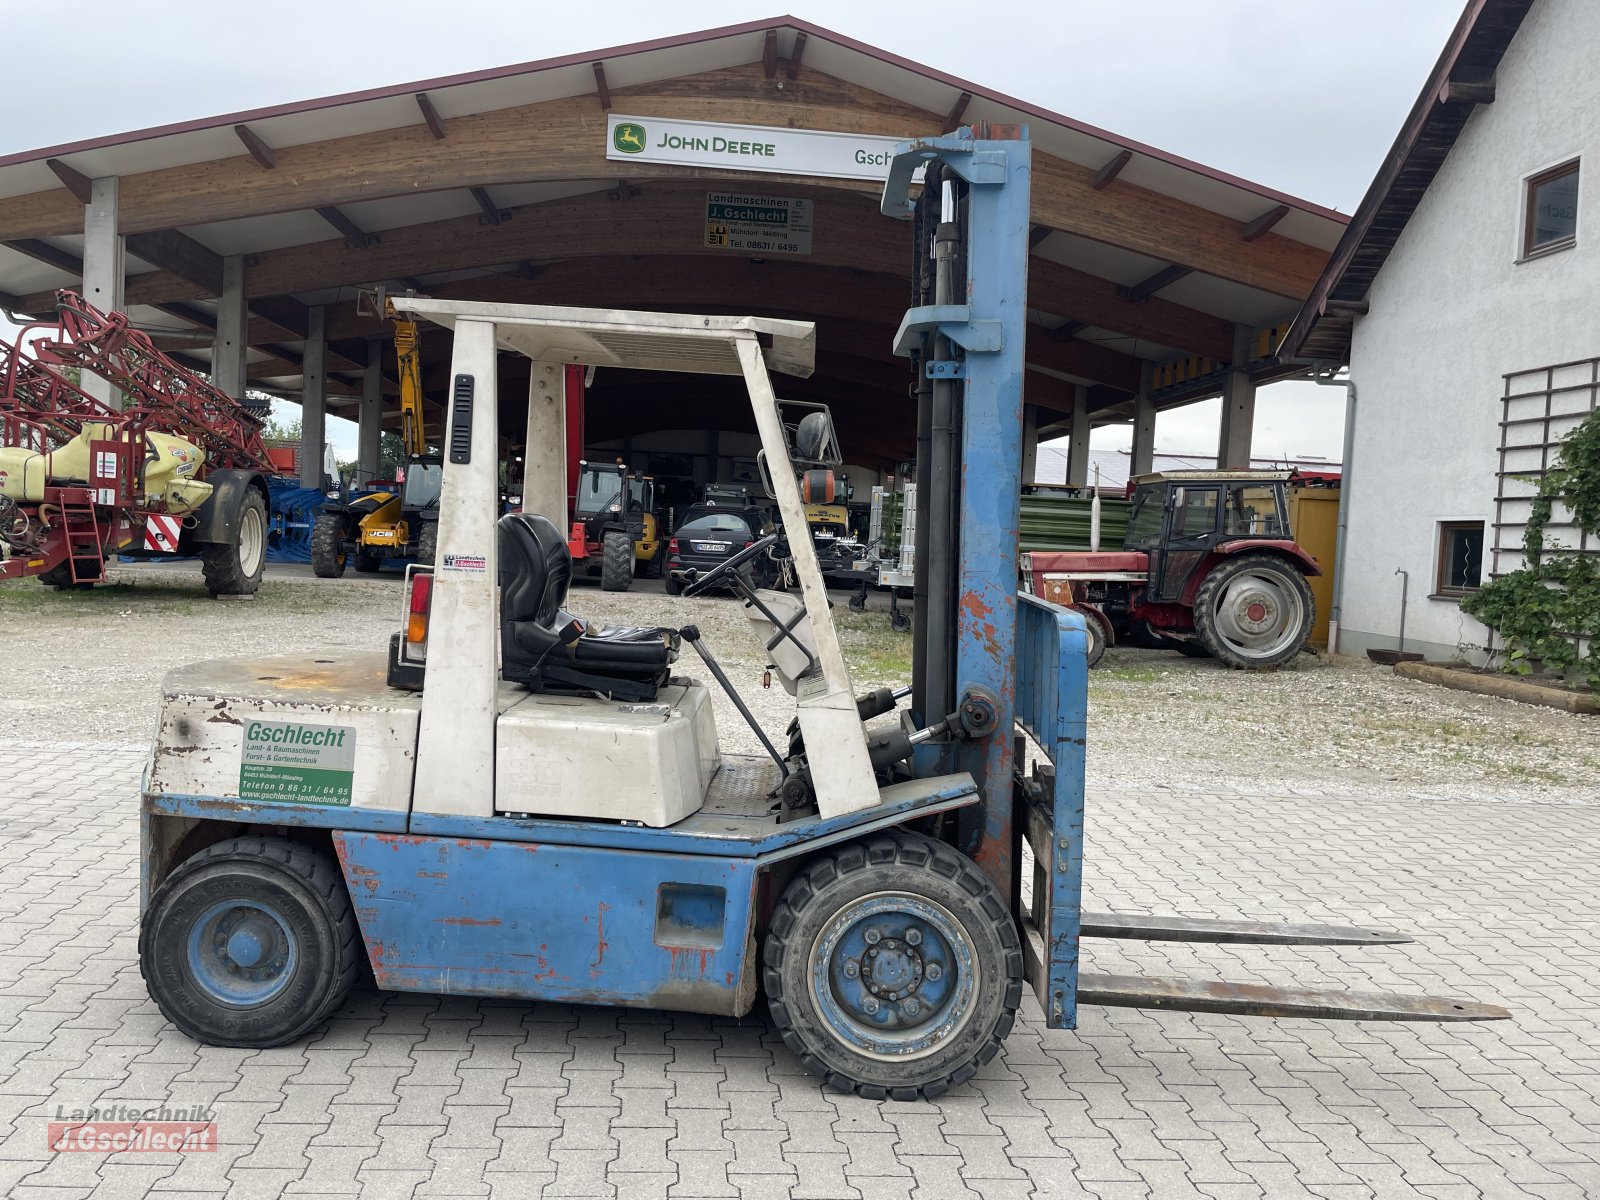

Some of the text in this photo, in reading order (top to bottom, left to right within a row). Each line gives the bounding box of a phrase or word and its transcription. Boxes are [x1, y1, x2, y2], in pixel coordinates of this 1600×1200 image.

[656, 132, 776, 157] JOHN DEERE
[708, 193, 789, 207] Landmaschinen
[711, 207, 720, 218] J.
[724, 208, 786, 222] Gschlecht
[729, 239, 744, 248] Tel.
[777, 243, 798, 252] 6495
[247, 722, 346, 747] Gschlecht
[246, 743, 265, 751] Land-
[273, 746, 320, 755] Baumaschinen
[273, 755, 318, 764] Gartentechnik
[242, 780, 275, 790] Telefon
[278, 783, 285, 791] 0
[287, 784, 298, 792] 86
[302, 785, 312, 793] 31
[323, 786, 334, 794] 64
[337, 787, 349, 796] 95
[241, 791, 349, 805] www.gschlecht-landtechnik.de
